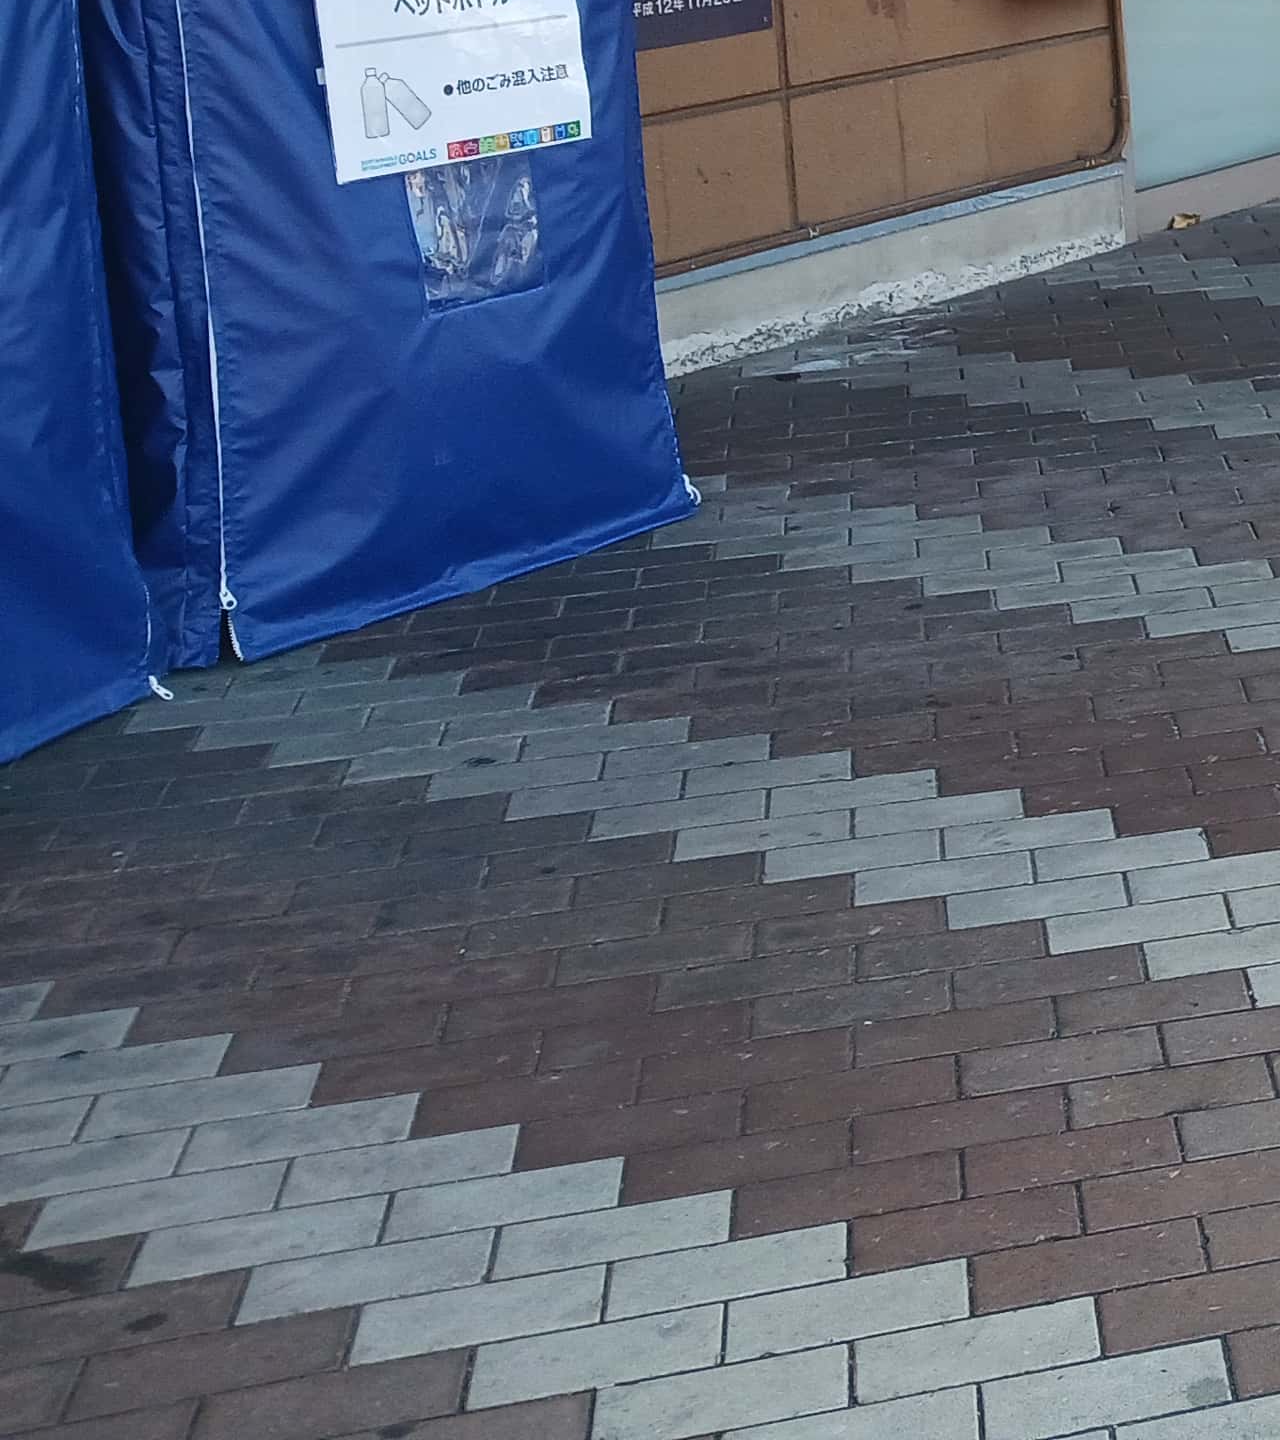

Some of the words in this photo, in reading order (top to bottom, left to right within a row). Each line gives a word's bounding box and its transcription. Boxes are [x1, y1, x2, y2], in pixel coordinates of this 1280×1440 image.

[456, 64, 569, 95] 他のごみ混入注意
